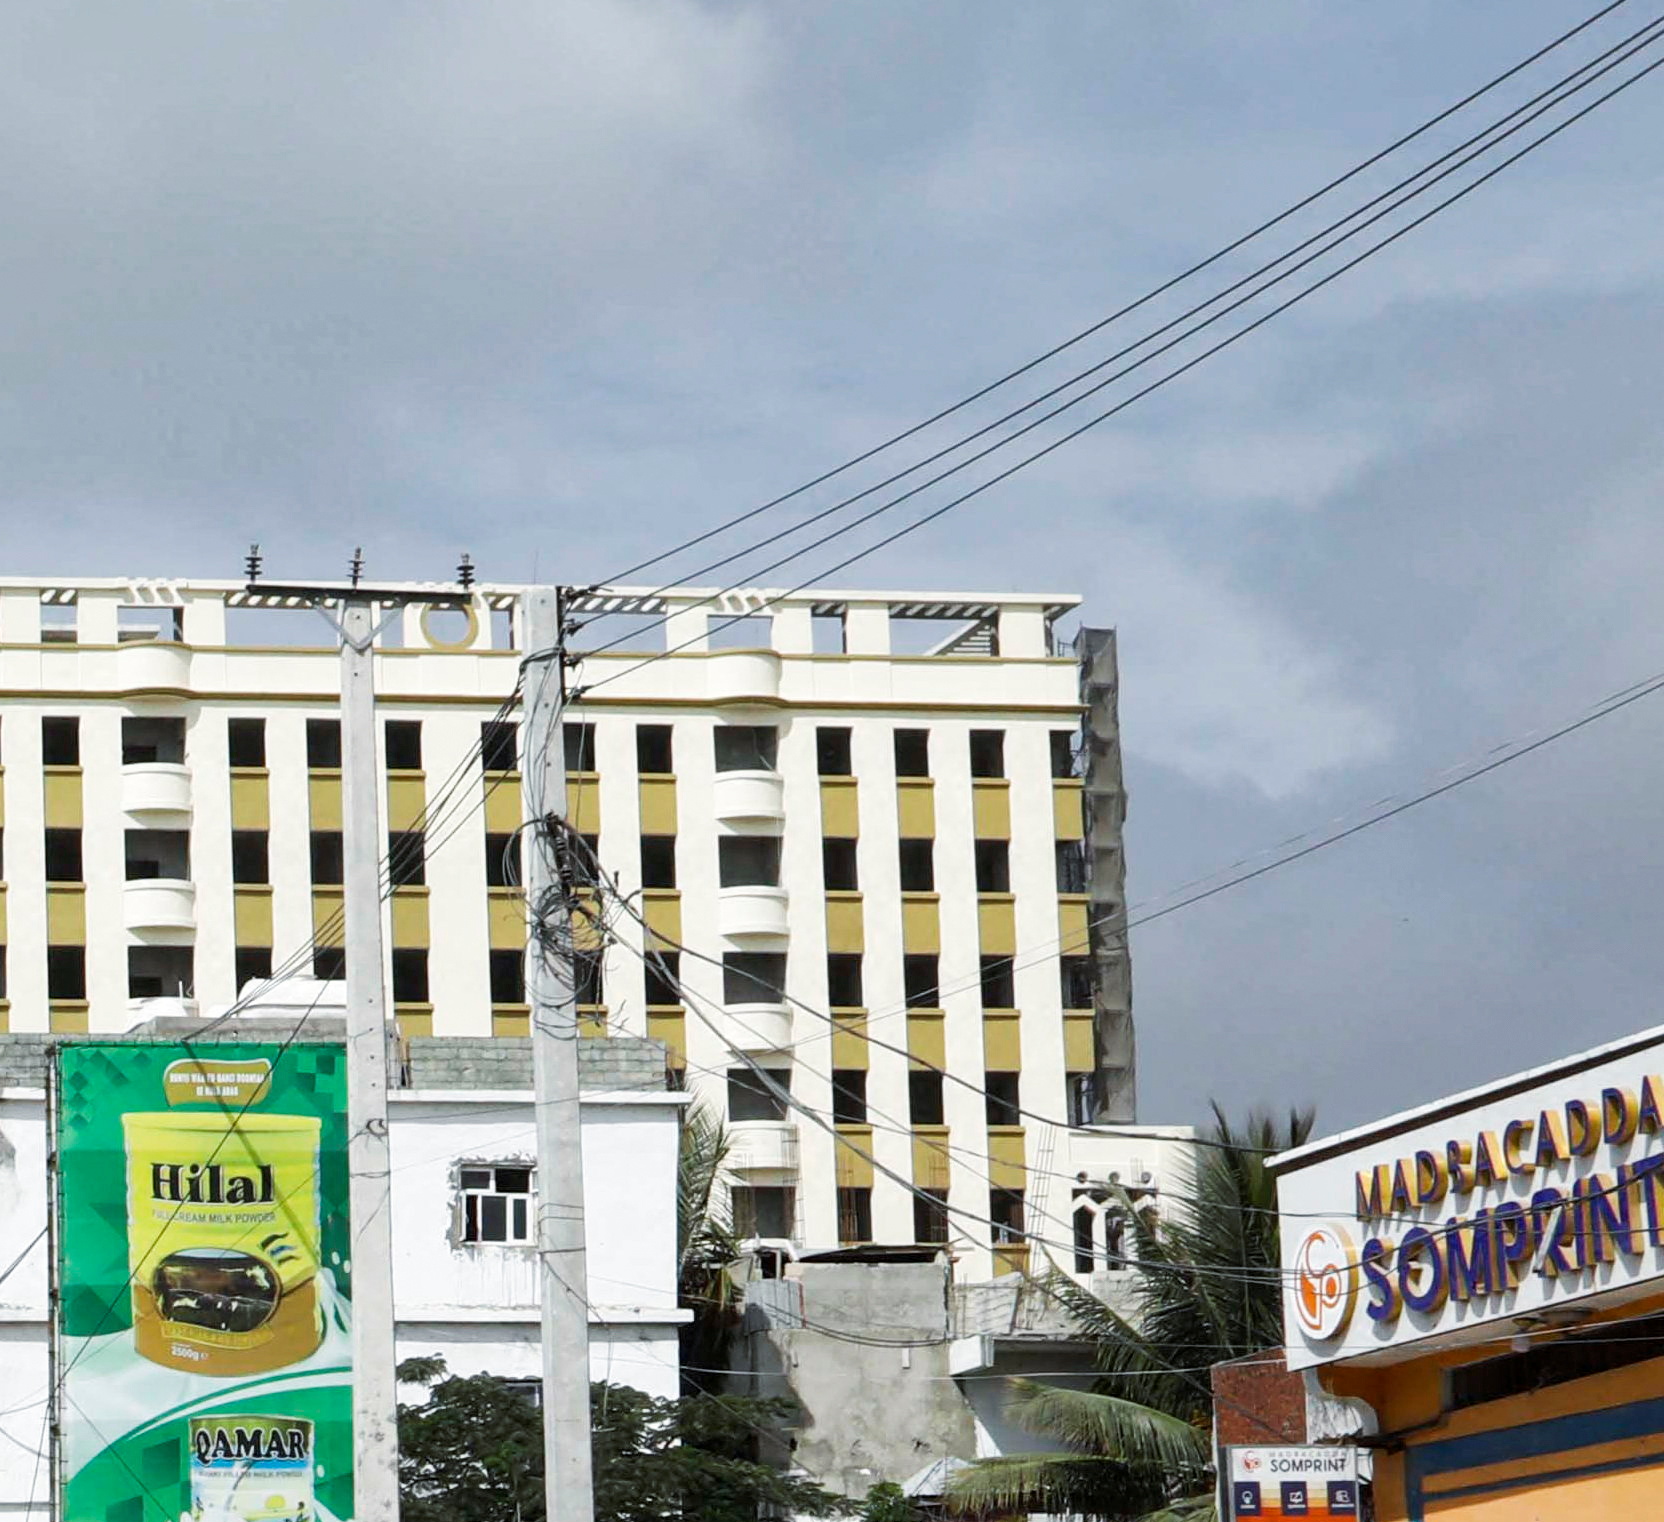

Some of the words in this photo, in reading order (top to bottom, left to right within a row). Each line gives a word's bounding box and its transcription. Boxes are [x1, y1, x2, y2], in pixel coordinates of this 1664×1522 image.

[150, 1162, 275, 1205] Hilal
[208, 1212, 234, 1223] MILK
[195, 1428, 307, 1464] QAMAR
[1270, 1459, 1347, 1472] SOMPRINT
